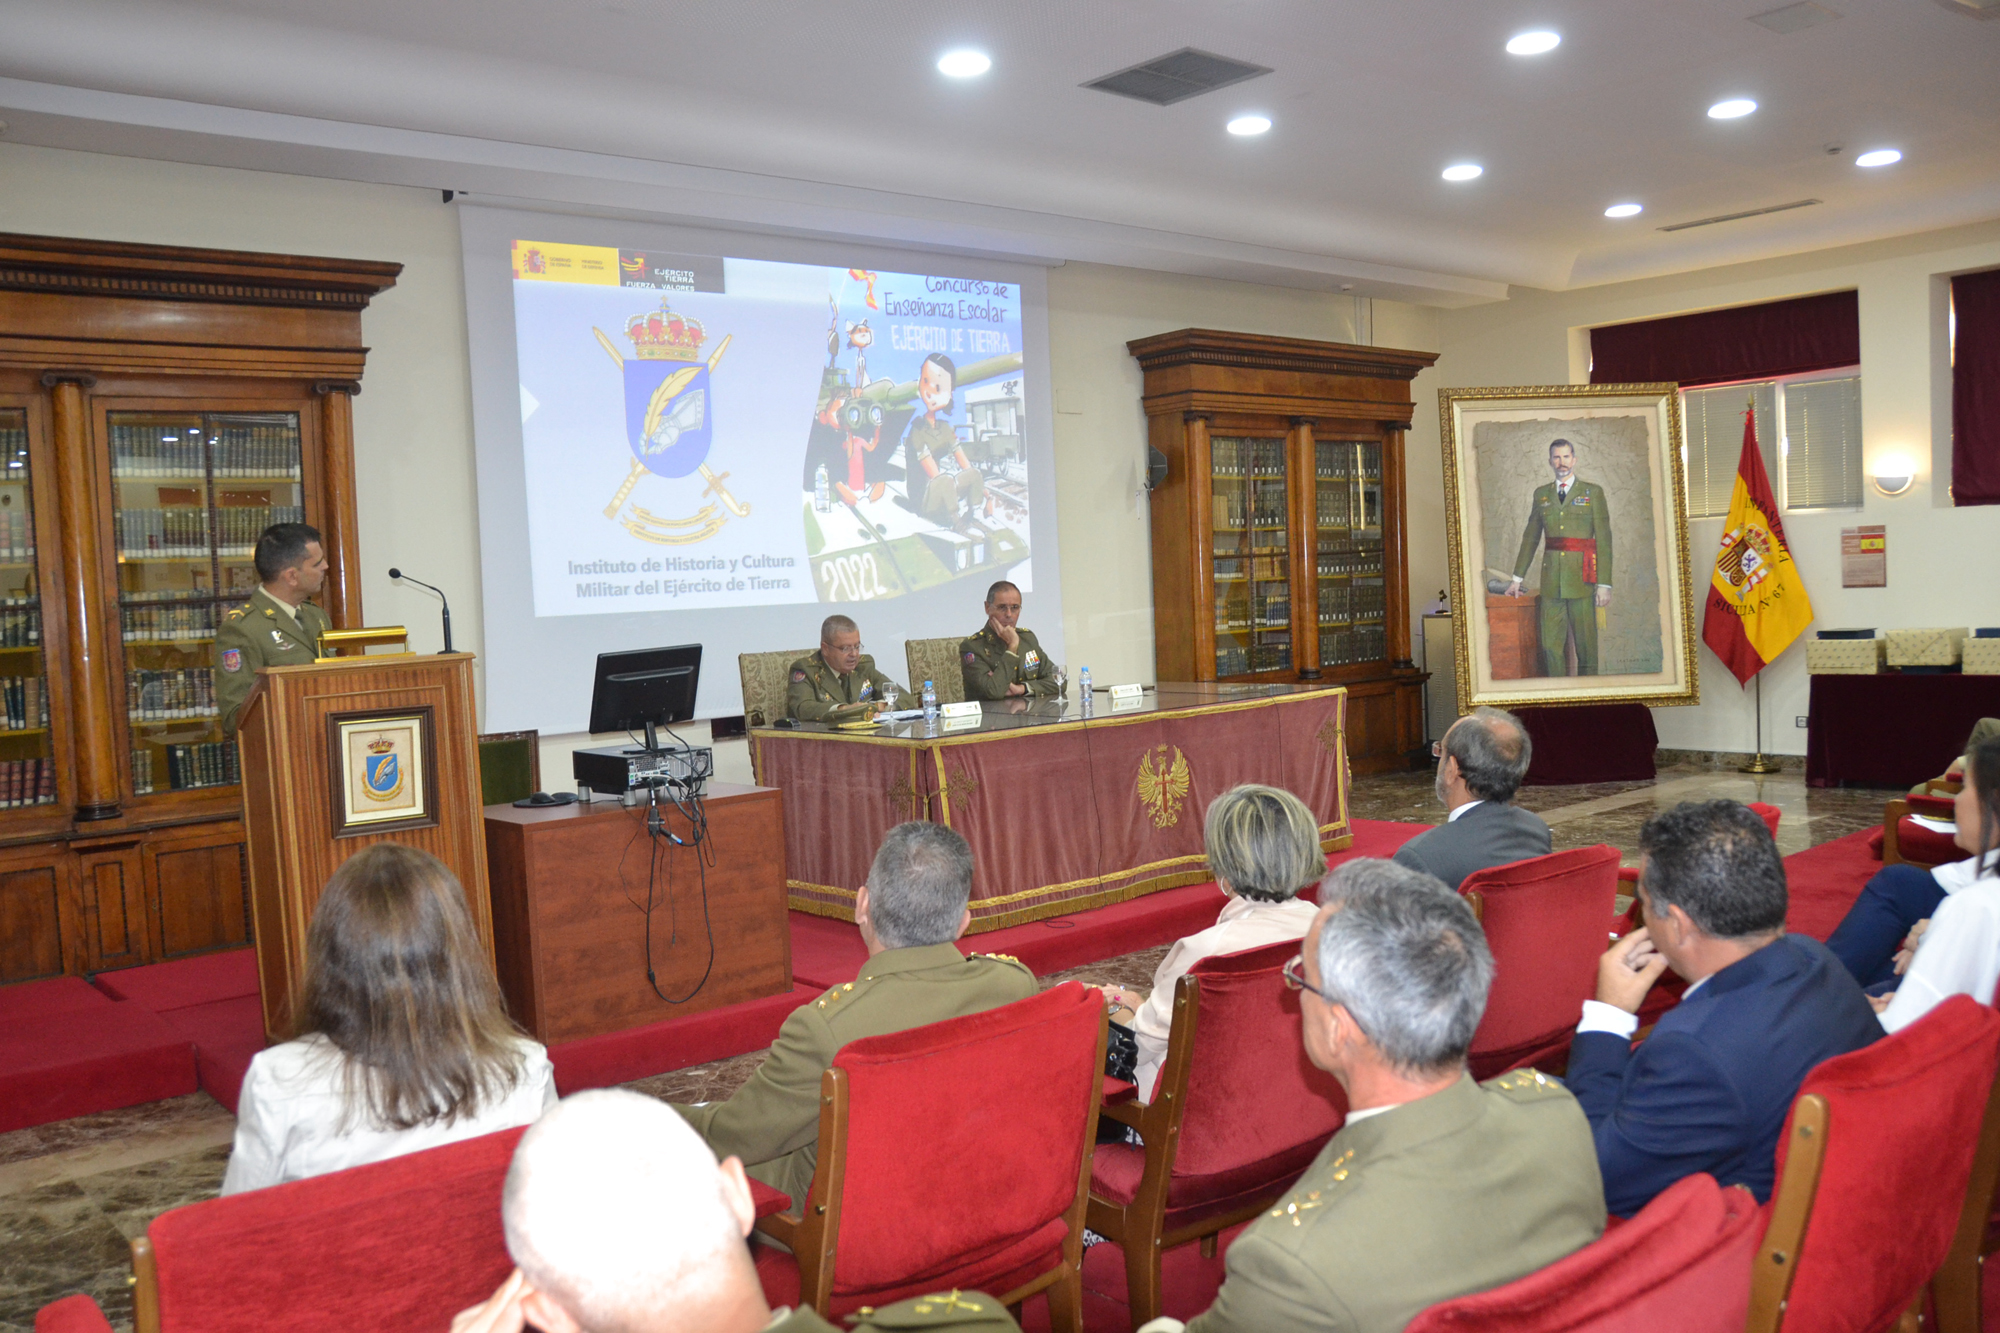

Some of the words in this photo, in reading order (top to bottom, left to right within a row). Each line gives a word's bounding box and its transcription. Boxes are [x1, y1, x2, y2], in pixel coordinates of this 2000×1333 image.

[626, 281, 656, 289] FUERZA
[661, 284, 695, 292] VALORES
[664, 275, 694, 284] TIERRA
[925, 275, 989, 296] Concurso
[992, 282, 1008, 299] de
[884, 292, 954, 319] Enseñanza
[958, 299, 1008, 323] Escolar
[891, 322, 947, 351] EJÉRCITO
[951, 328, 964, 352] DE
[967, 329, 1011, 353] TIERRA
[568, 559, 637, 575] Instituto
[640, 558, 661, 572] de
[665, 557, 725, 572] Historia
[729, 559, 738, 573] y
[741, 554, 795, 569] Cultura
[576, 581, 630, 598] Militar
[633, 580, 660, 595] del
[664, 577, 722, 598] Ejército
[725, 577, 745, 591] de
[747, 575, 791, 590] Tierra
[821, 552, 888, 602] 2022
